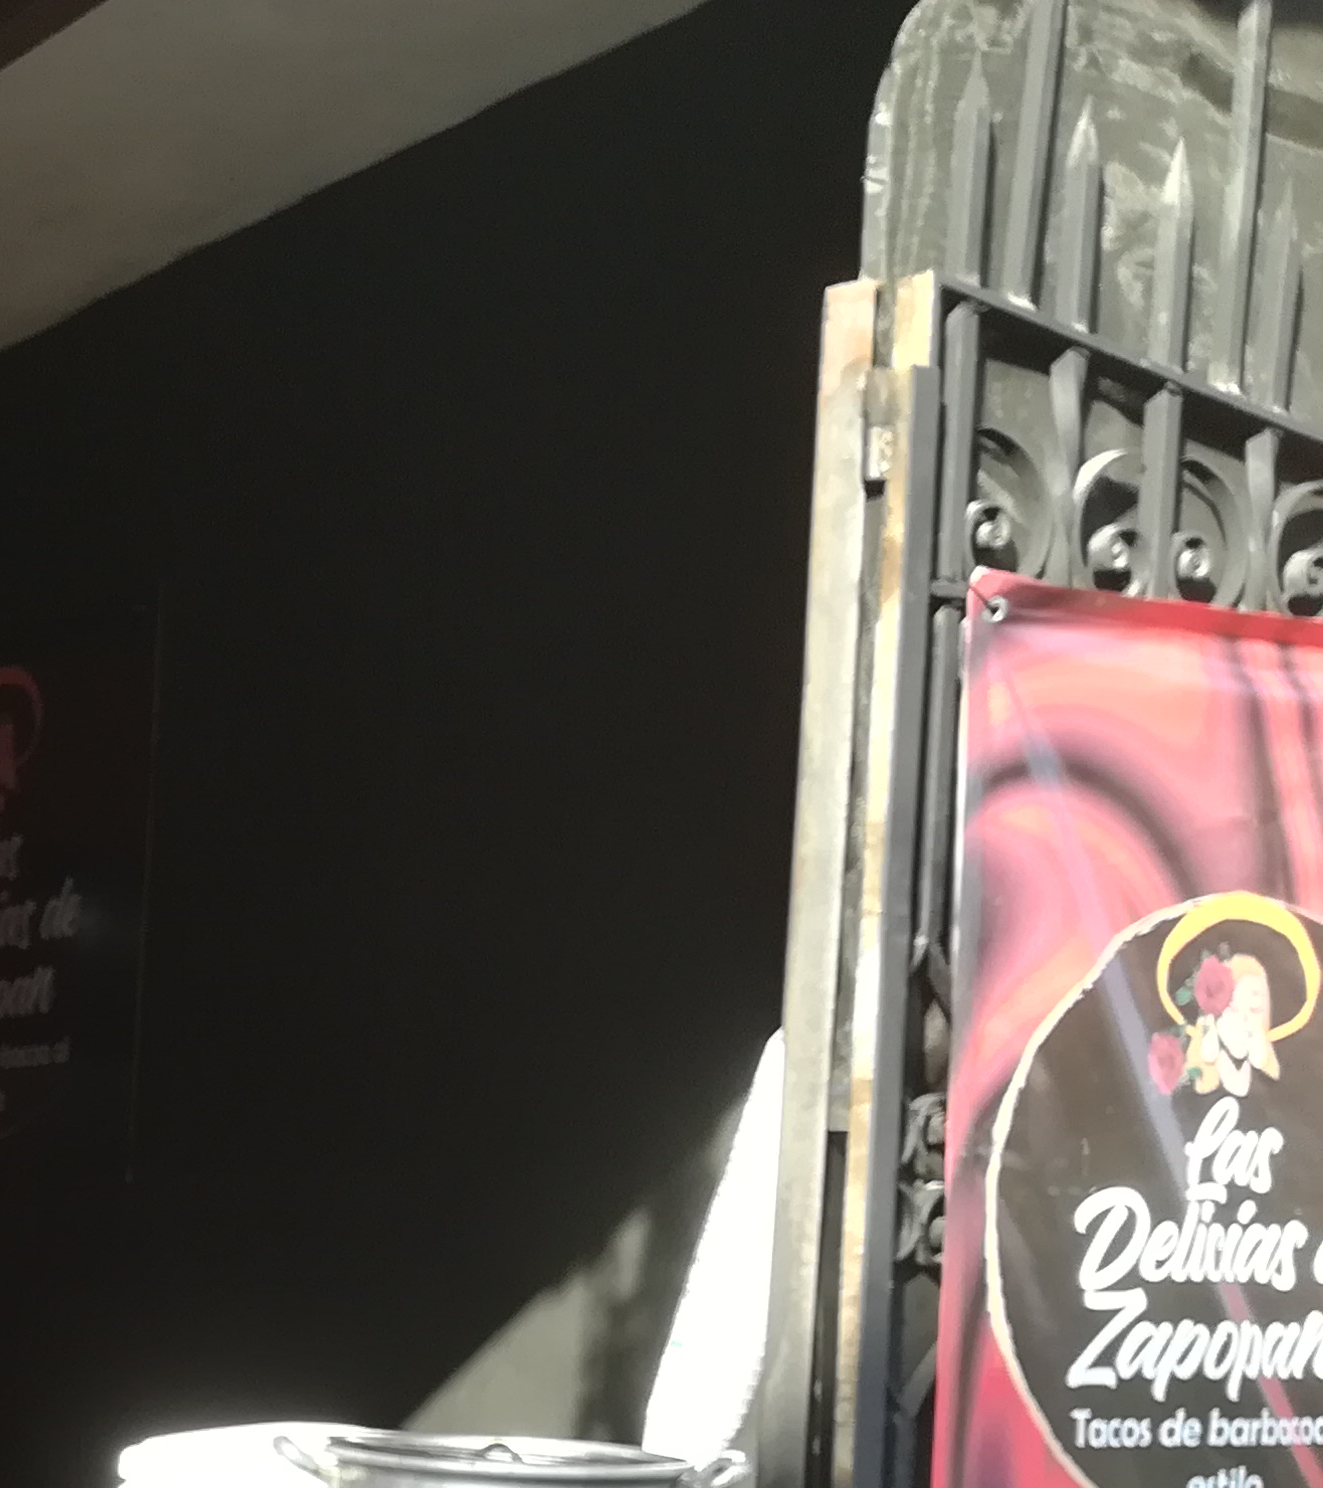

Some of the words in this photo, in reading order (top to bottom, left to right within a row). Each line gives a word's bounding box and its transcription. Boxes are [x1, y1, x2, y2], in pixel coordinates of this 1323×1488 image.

[1183, 1097, 1284, 1204] Las
[1073, 1186, 1309, 1292] Delicias
[1069, 1408, 1151, 1448] Tacos
[1158, 1408, 1202, 1448] de
